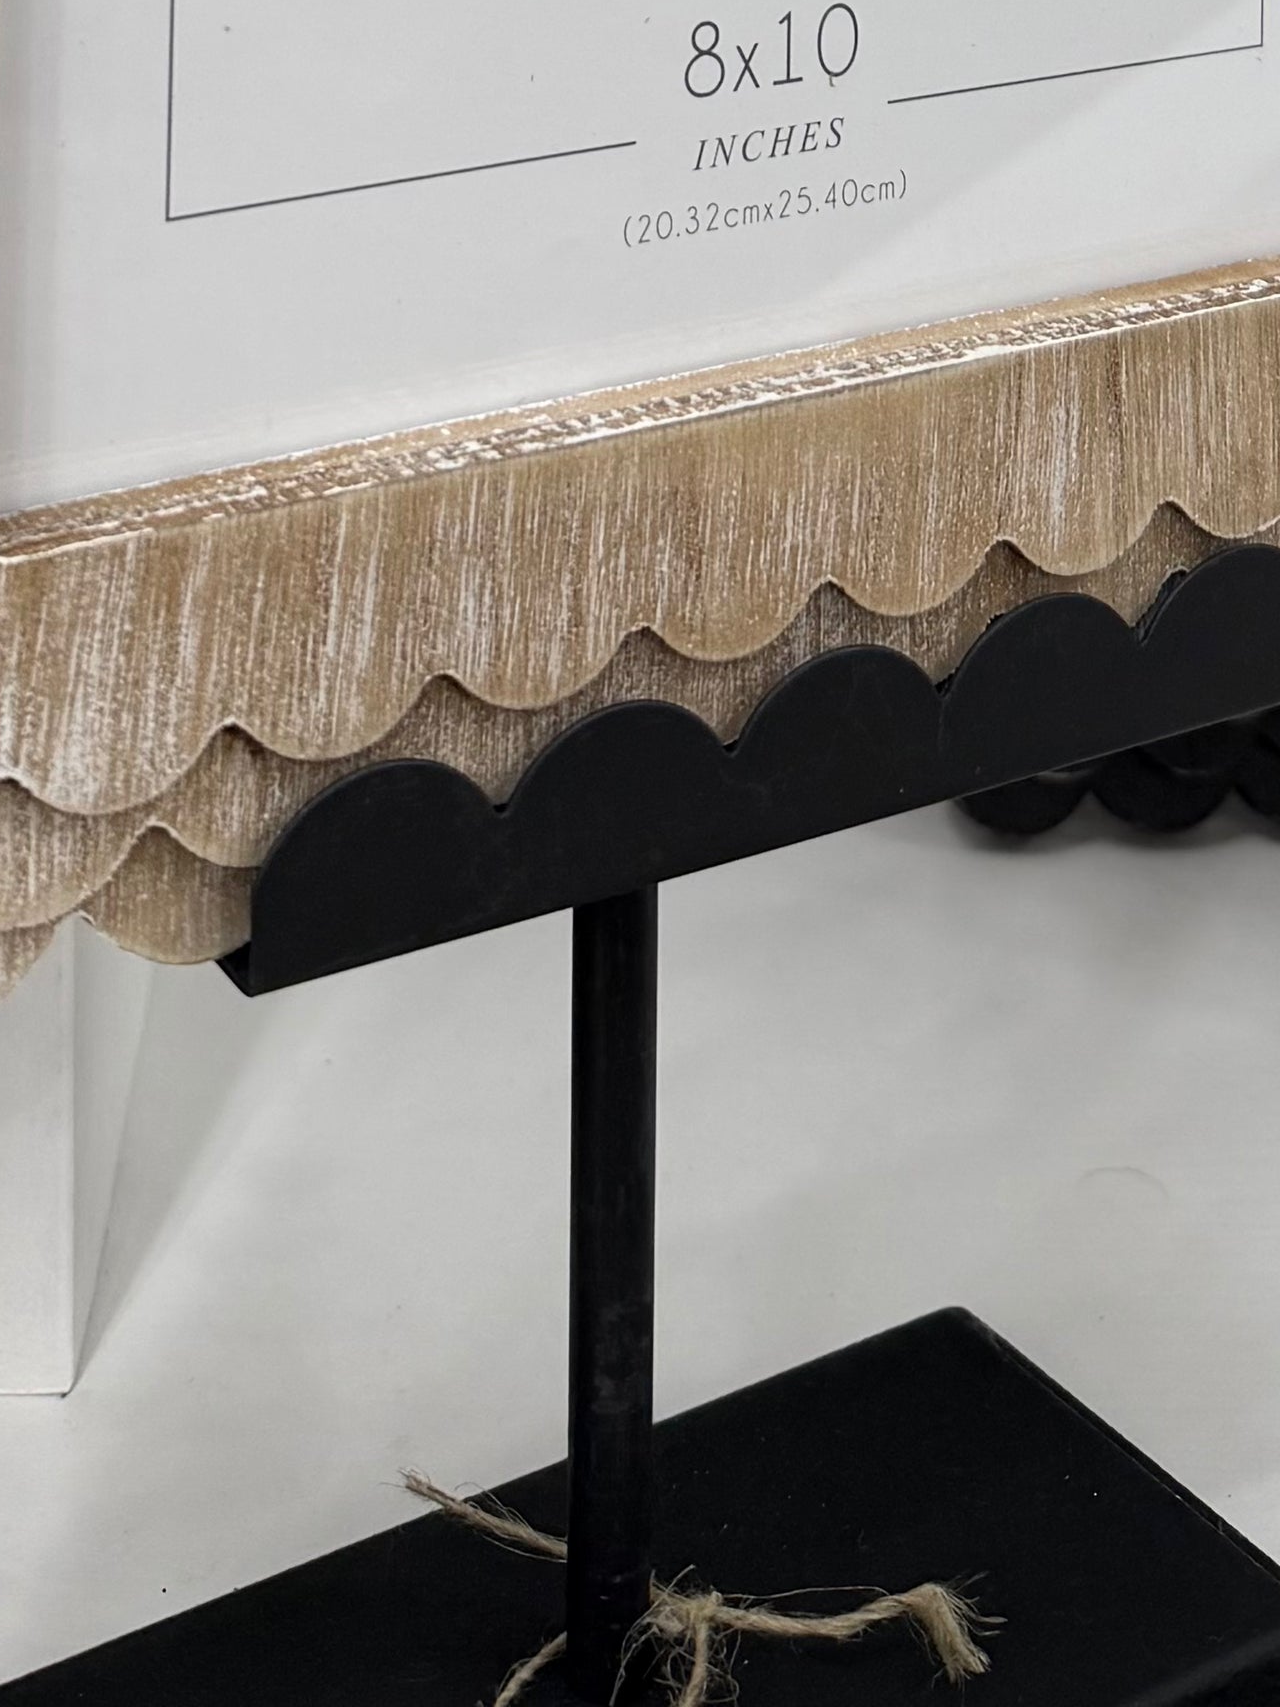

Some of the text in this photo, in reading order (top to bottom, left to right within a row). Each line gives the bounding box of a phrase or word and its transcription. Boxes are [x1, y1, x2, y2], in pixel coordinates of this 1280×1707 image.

[684, 3, 859, 98] 8x10
[692, 117, 845, 171] INCHES
[623, 169, 907, 247] (20.32cmx25.40cm)
